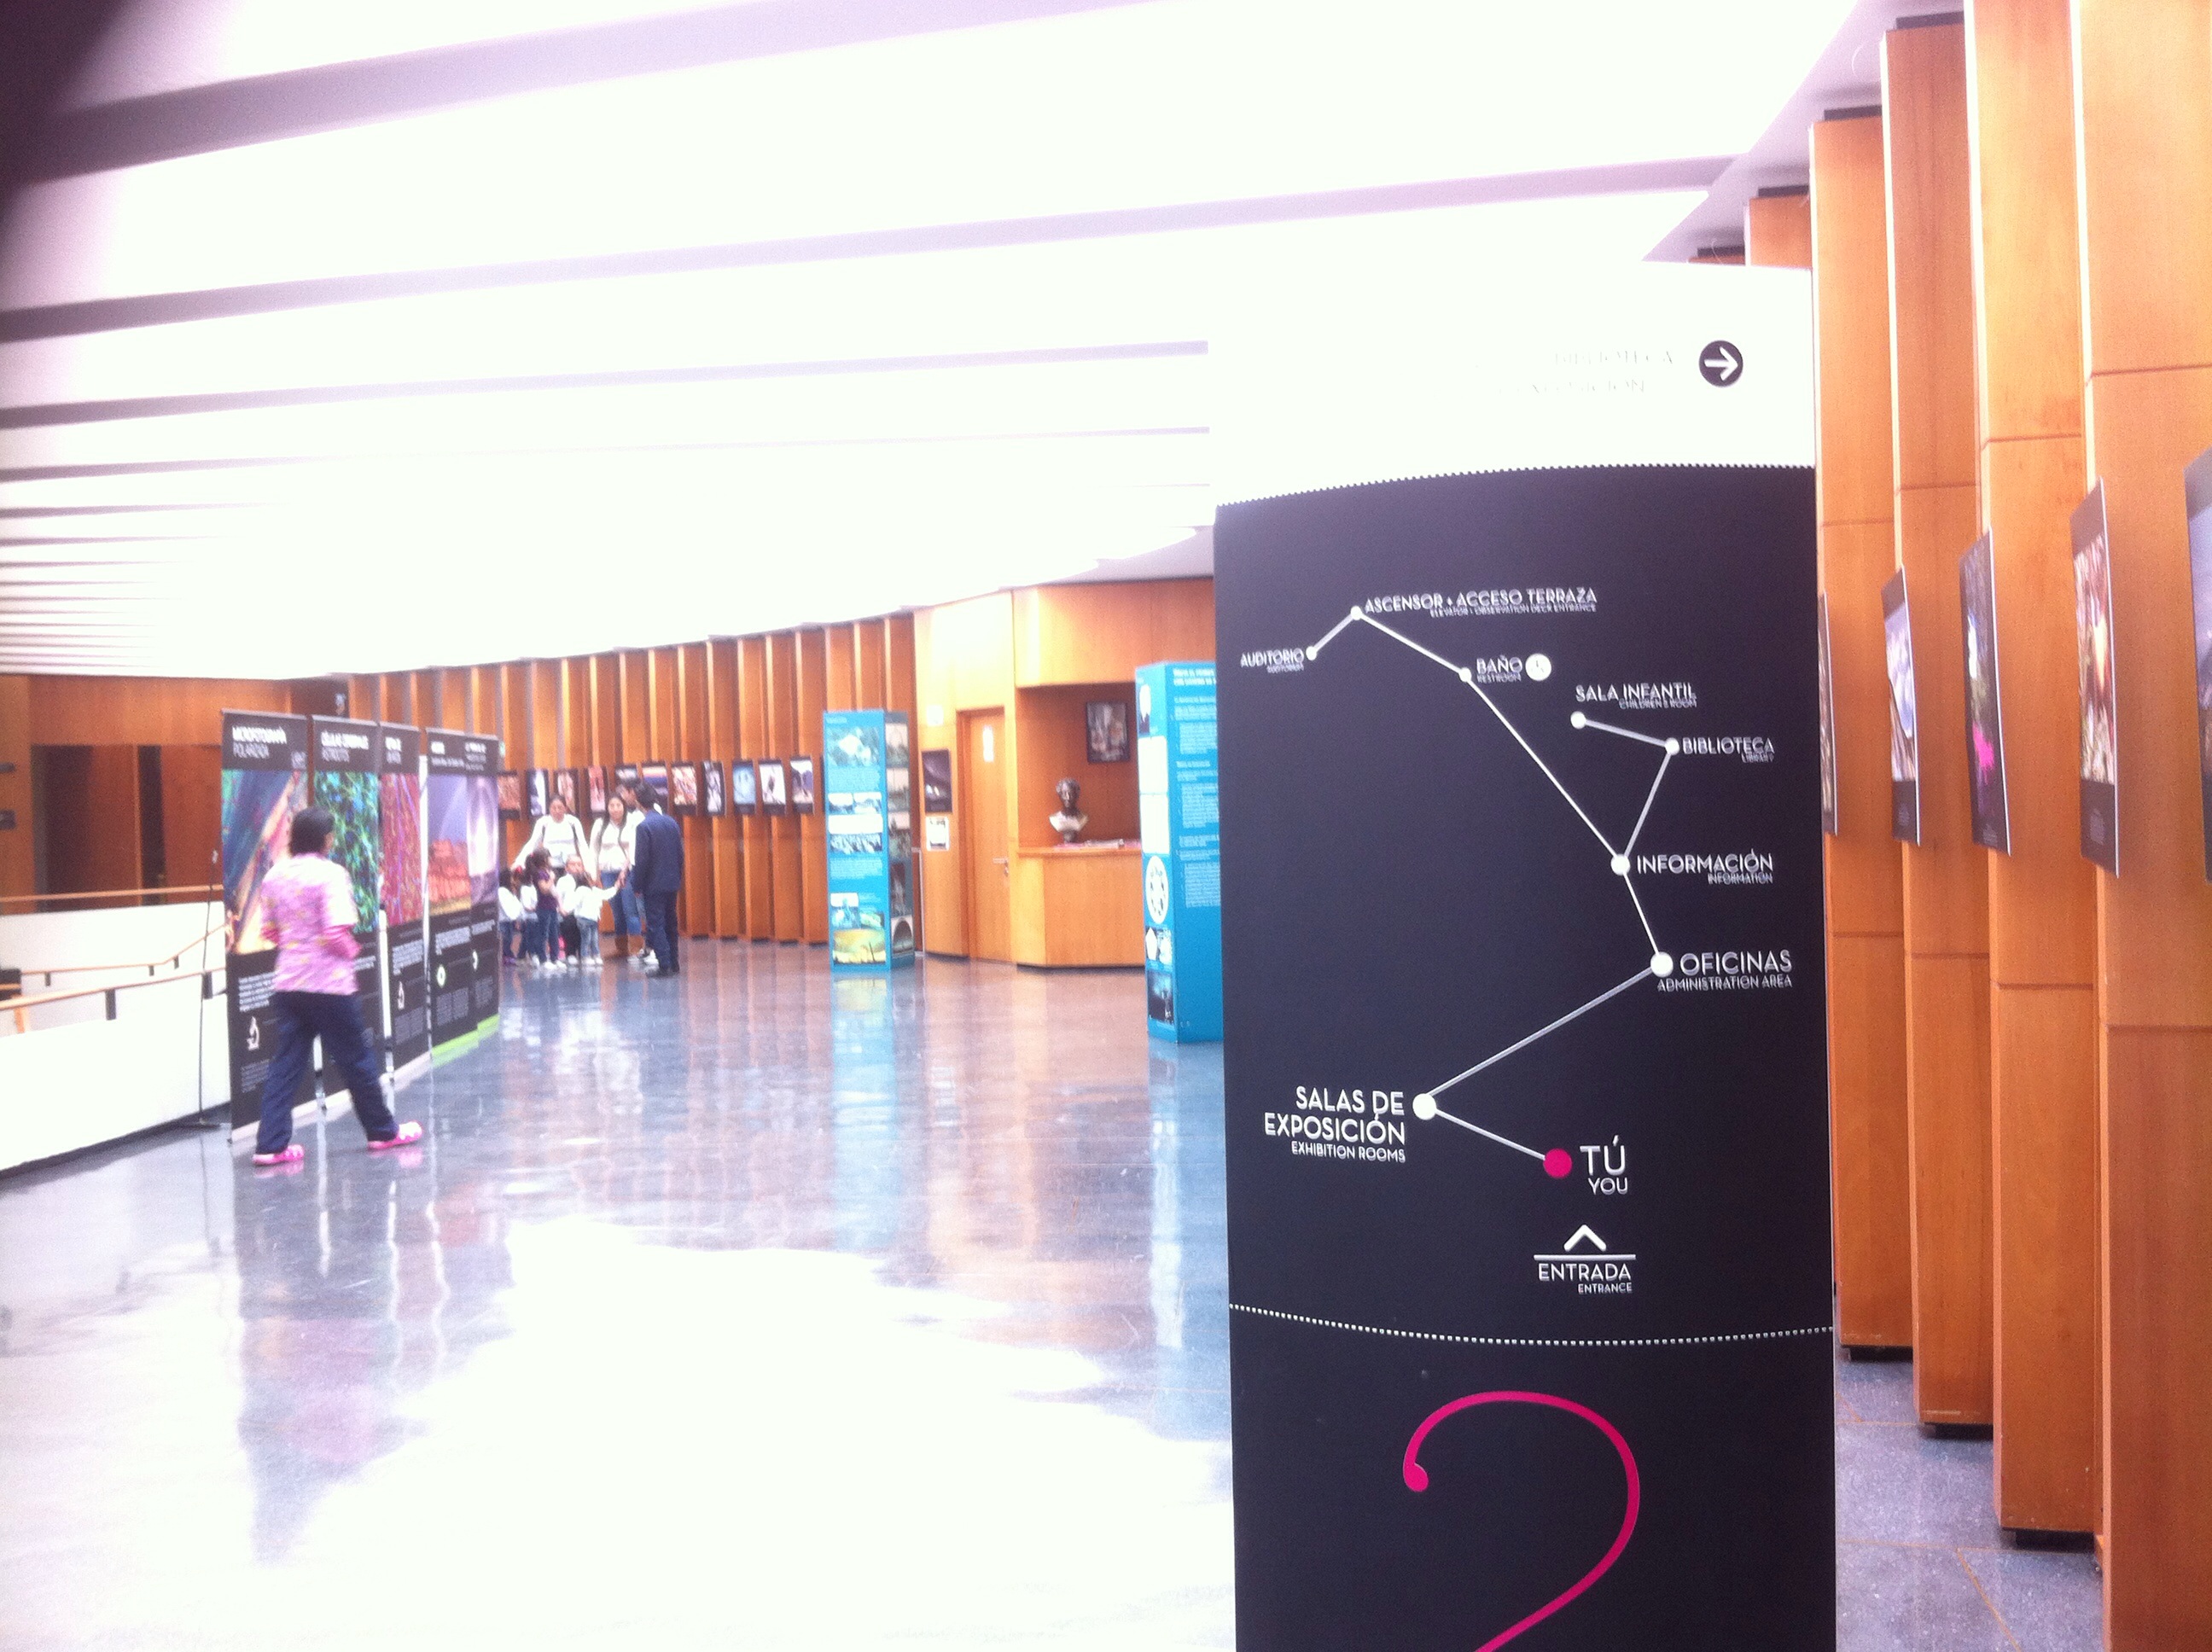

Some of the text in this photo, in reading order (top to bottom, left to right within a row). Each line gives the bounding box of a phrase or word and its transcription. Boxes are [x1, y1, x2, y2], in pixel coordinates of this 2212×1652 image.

[1366, 592, 1443, 614] ASCENSOR
[1457, 589, 1522, 608] ACCESO
[1527, 587, 1598, 605] TERRAZA
[1240, 648, 1304, 668] AUDITORIO
[1476, 654, 1522, 673] BAÑO
[1575, 683, 1697, 702] SALA INFANTIL
[1670, 697, 1697, 708] ROOM
[1682, 736, 1775, 754] BIBLIOTECA
[1637, 848, 1773, 874] INFORMACIÓN
[1708, 872, 1773, 885] INFORMATION
[1679, 949, 1792, 975] OFICINAS
[1657, 974, 1792, 992] ADMINISTRATION AREA
[1295, 1085, 1405, 1115] SALAS DE
[1264, 1112, 1406, 1145] EXPOSICIÓN
[1291, 1141, 1406, 1163] EXHIBITION ROOMS
[1580, 1135, 1626, 1176] TÚ
[1588, 1177, 1628, 1195] YOU
[1539, 1263, 1631, 1281] ENTRADA
[1578, 1283, 1632, 1294] ENTRANCE
